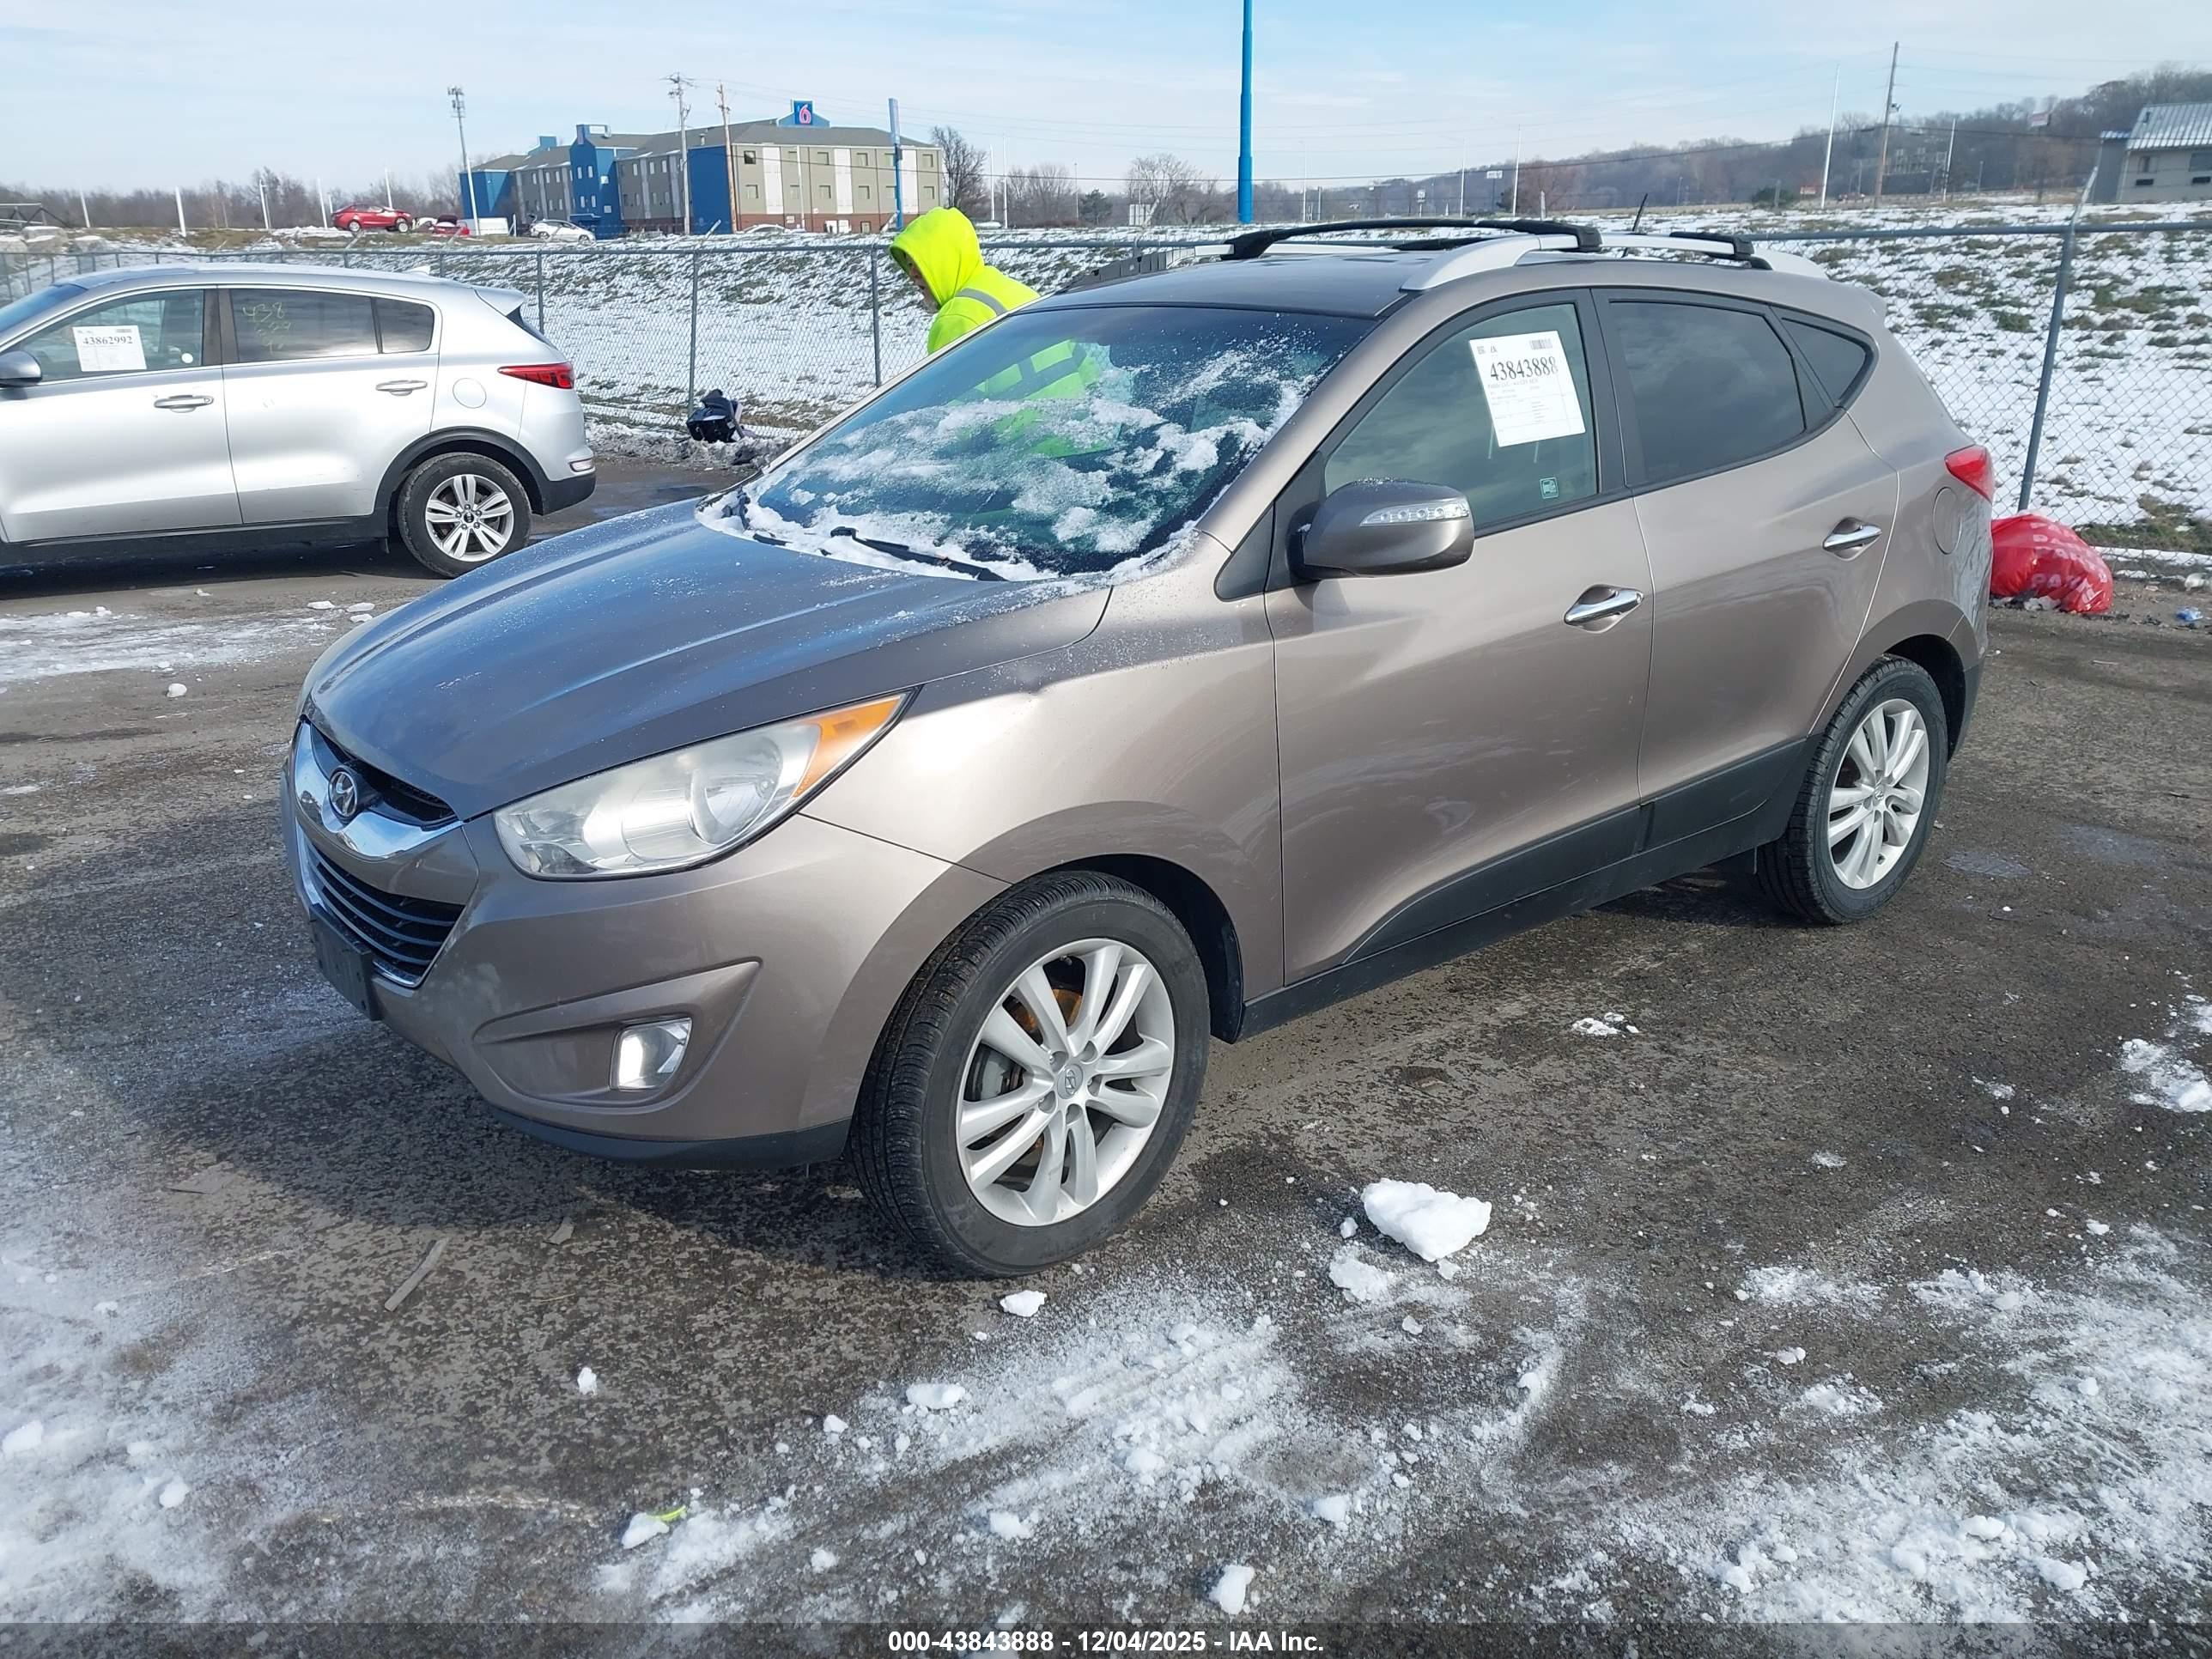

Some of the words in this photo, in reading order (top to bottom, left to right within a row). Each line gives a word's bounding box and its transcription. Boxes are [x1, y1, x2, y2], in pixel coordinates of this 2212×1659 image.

[799, 104, 811, 124] 6
[82, 336, 133, 344] 43862992
[1490, 356, 1559, 381] 43843888
